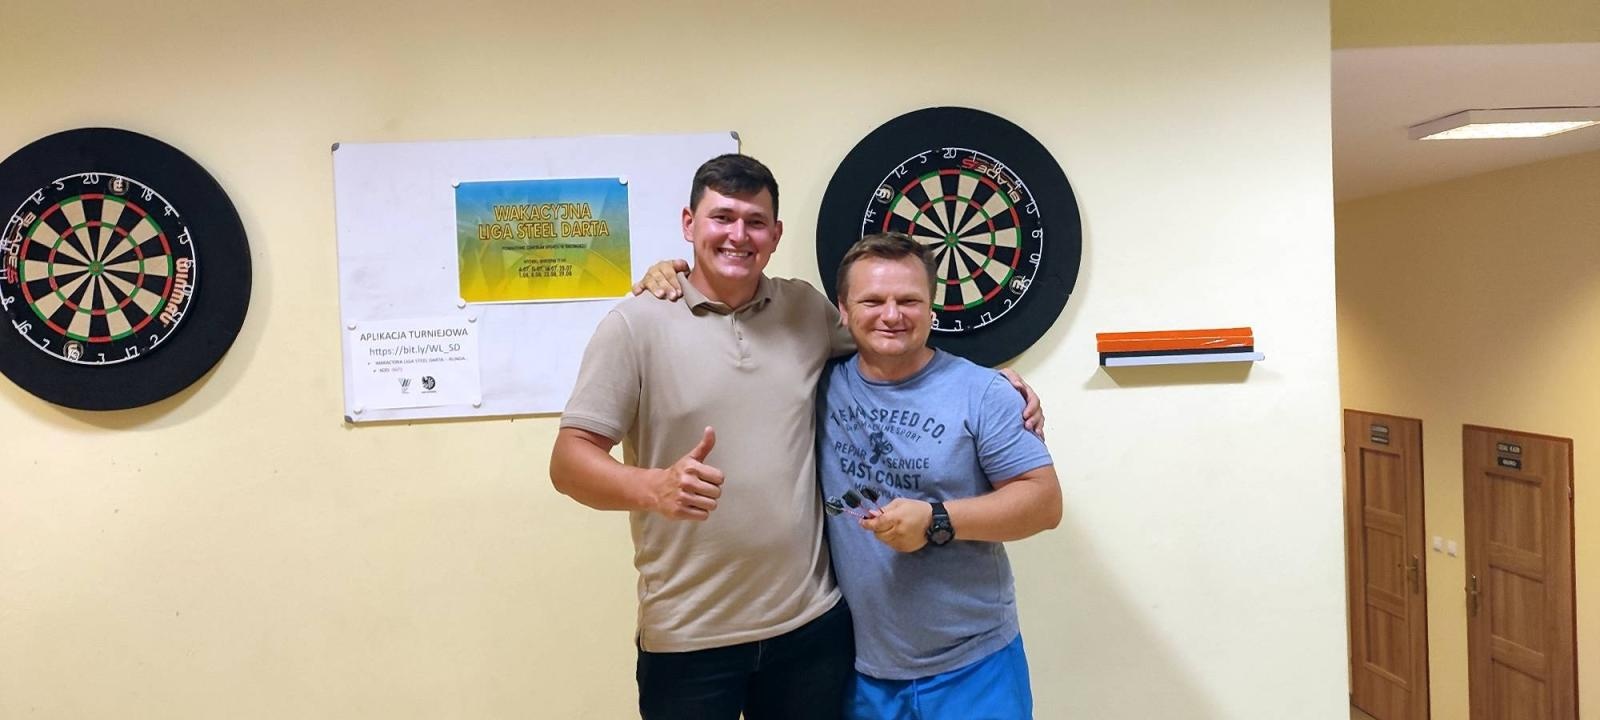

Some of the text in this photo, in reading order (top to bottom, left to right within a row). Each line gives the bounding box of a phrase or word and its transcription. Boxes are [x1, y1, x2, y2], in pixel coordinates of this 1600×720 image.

[919, 153, 928, 164] 5
[943, 148, 957, 159] 20
[81, 172, 100, 185] 20
[894, 165, 908, 179] 12
[55, 181, 65, 191] 5
[31, 190, 46, 206] 12
[141, 185, 154, 202] 18
[164, 205, 174, 218] 4
[494, 203, 592, 221] WAKACYJNA
[864, 208, 877, 225] 14
[478, 220, 610, 240] LIGA STEEL DARTA
[1029, 252, 1041, 268] 10
[1003, 298, 1013, 310] 2
[954, 319, 963, 331] 3
[980, 311, 993, 327] 17
[16, 319, 32, 335] 16
[150, 333, 159, 347] 2
[360, 328, 468, 341] APLIKACJA TURNIEJOWA
[42, 337, 51, 350] 7
[369, 343, 461, 357] https://bit.ly/WL_SD
[97, 352, 106, 364] 3
[124, 345, 140, 360] 17
[831, 406, 946, 444] TEAM SPEED CO.
[886, 457, 930, 469] SERVICE
[840, 457, 872, 480] EAST
[876, 470, 921, 490] COAST
